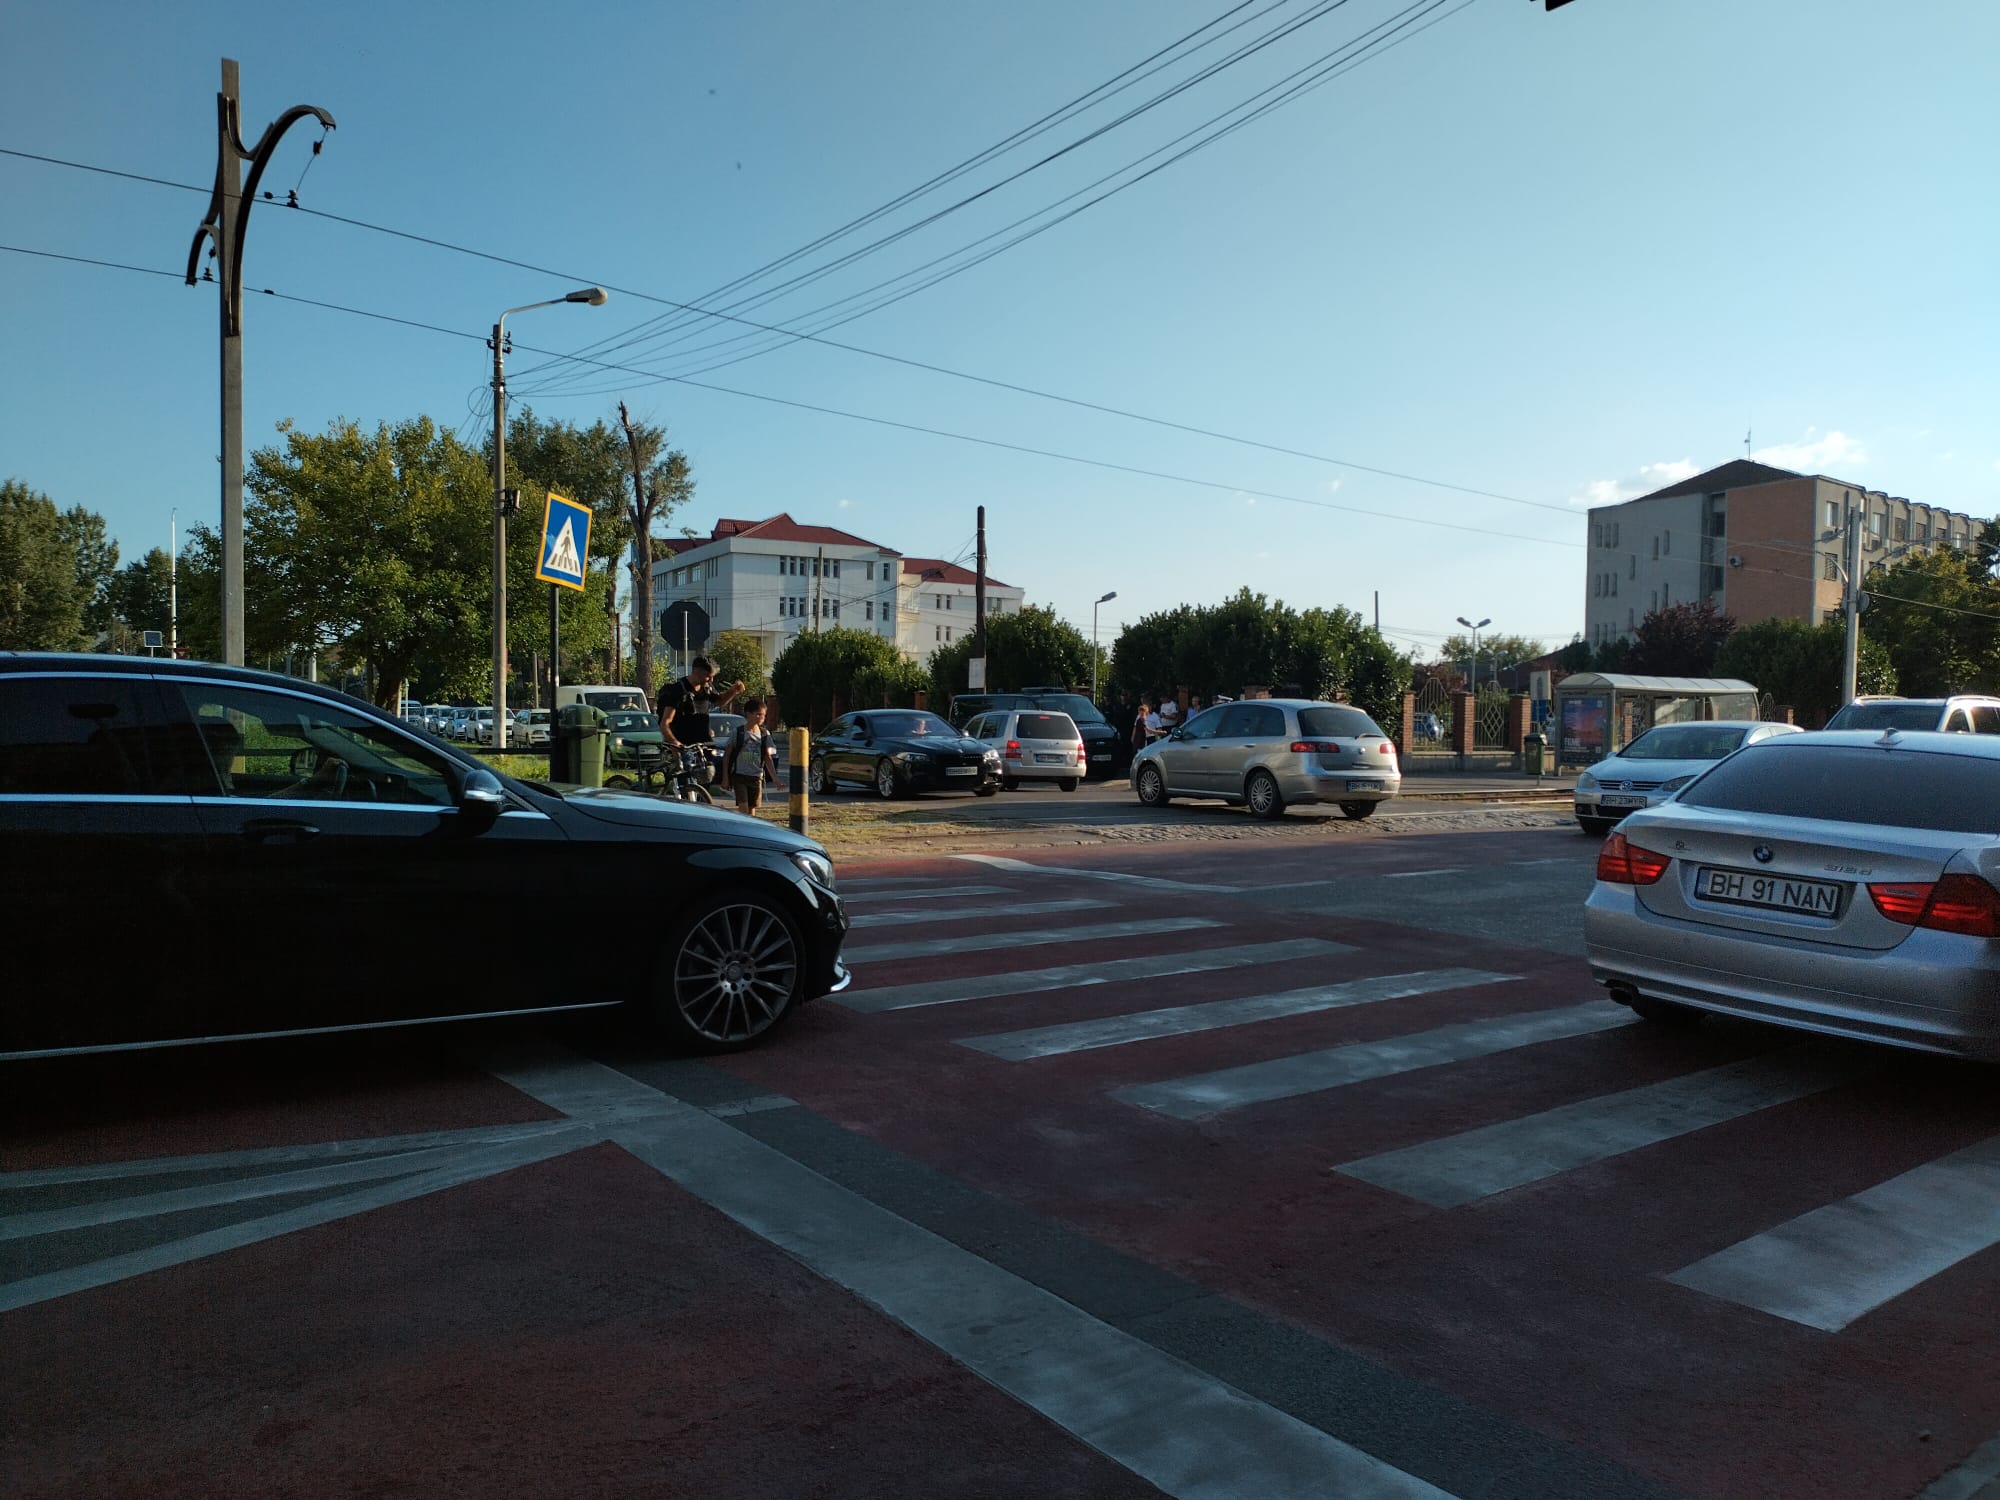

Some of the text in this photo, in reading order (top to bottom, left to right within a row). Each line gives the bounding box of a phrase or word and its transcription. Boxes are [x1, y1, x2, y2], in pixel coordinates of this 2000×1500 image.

[1709, 873, 1835, 911] BH 91 NAN
